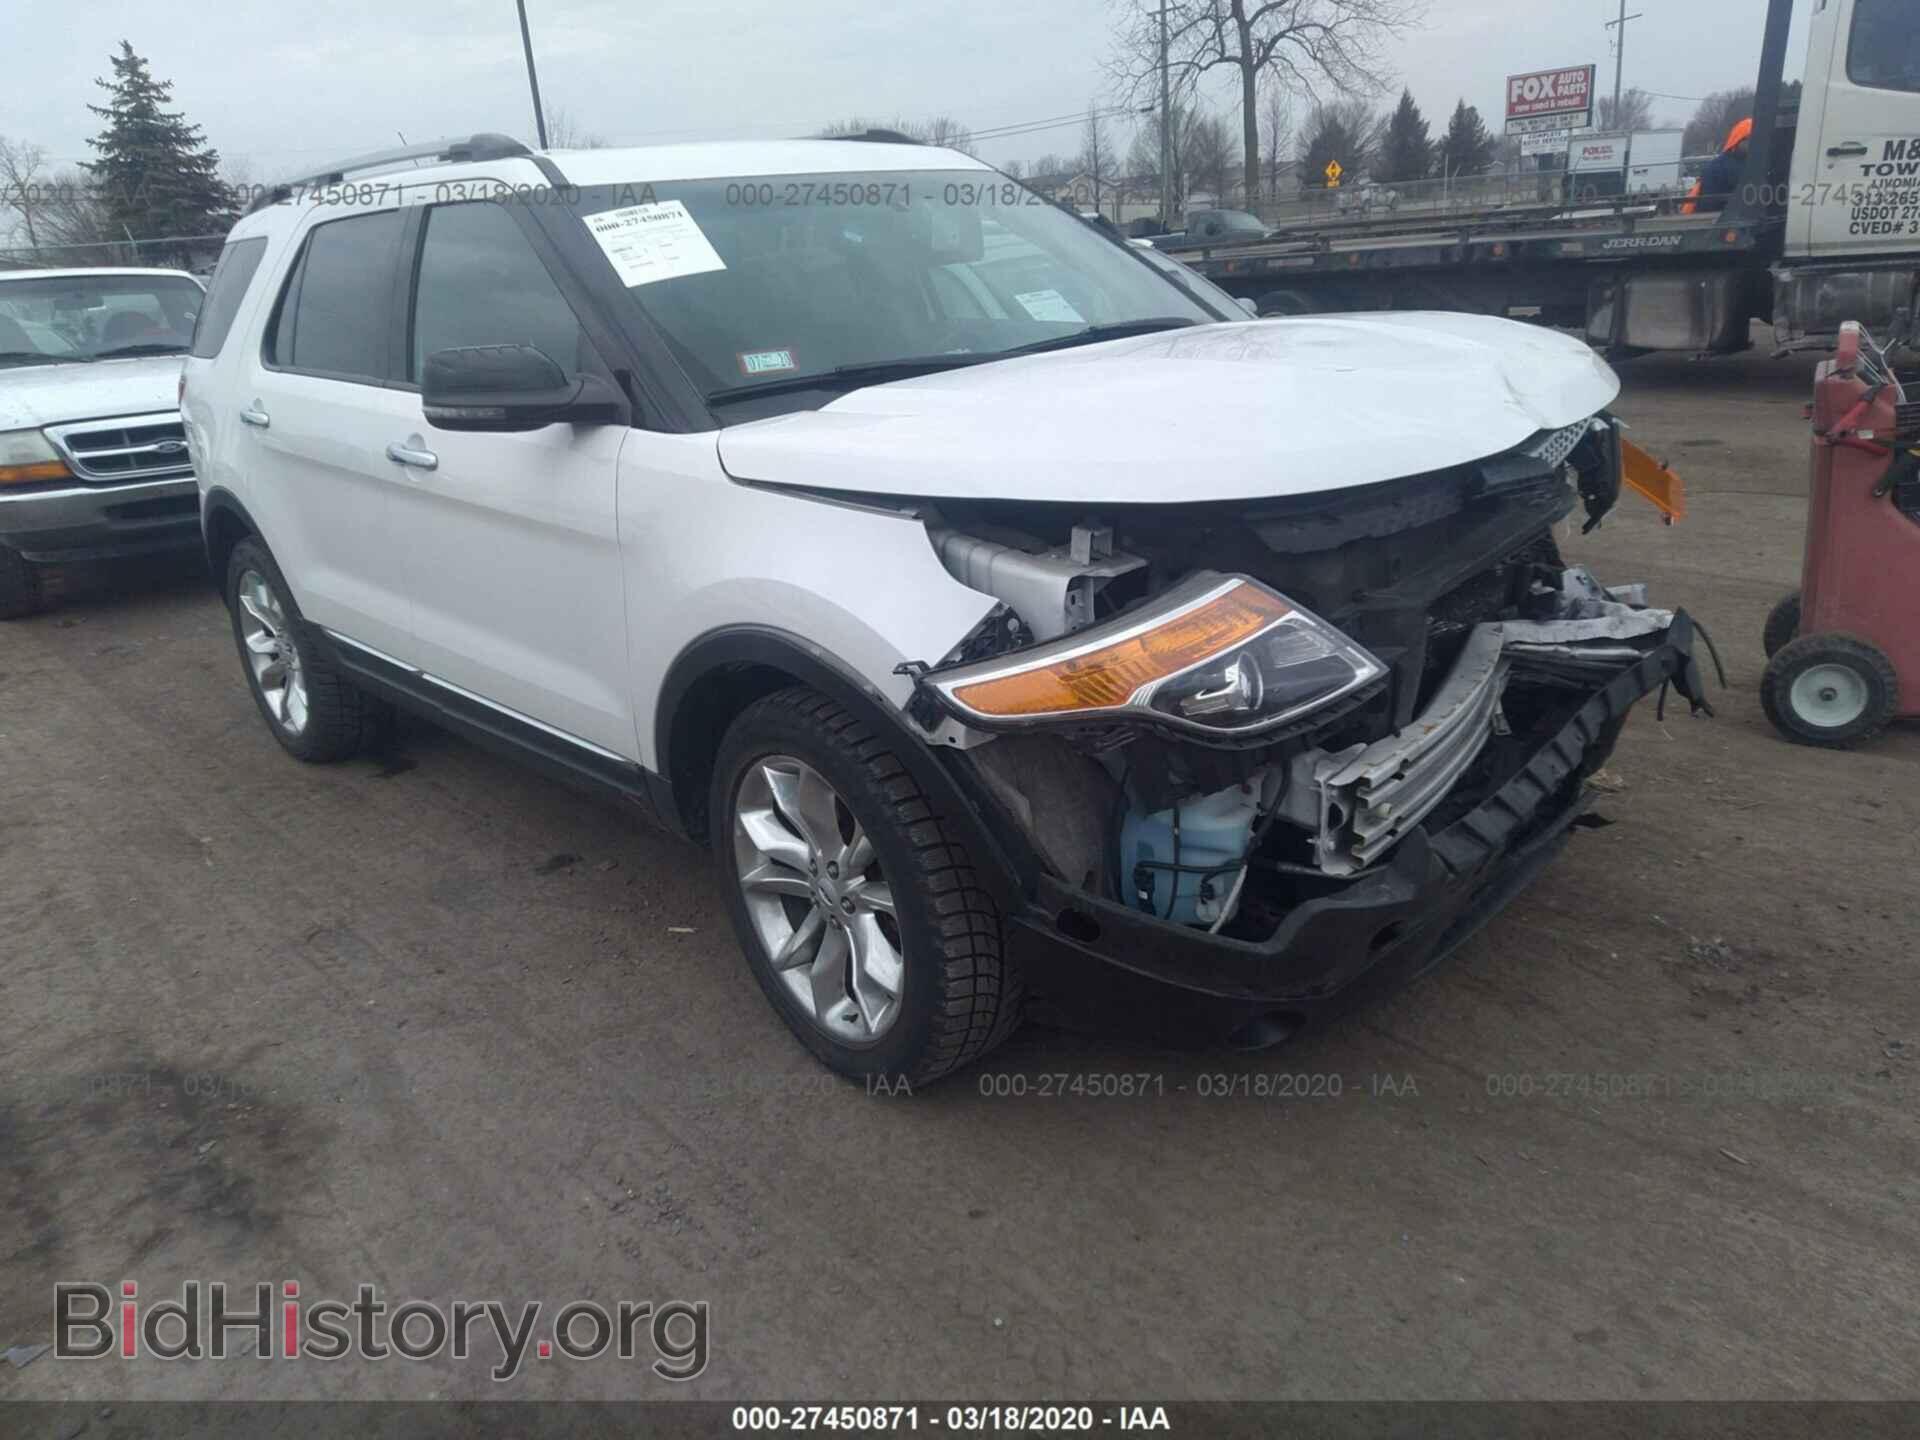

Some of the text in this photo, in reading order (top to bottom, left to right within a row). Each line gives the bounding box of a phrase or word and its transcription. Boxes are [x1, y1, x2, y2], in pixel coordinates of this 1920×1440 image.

[1558, 71, 1585, 84] AUTO
[1511, 75, 1556, 102] FOX
[1557, 83, 1586, 97] PARTS
[1871, 178, 1920, 189] LIVONI
[1851, 206, 1920, 220] USDOT 27
[1849, 221, 1919, 235] CVED# 3
